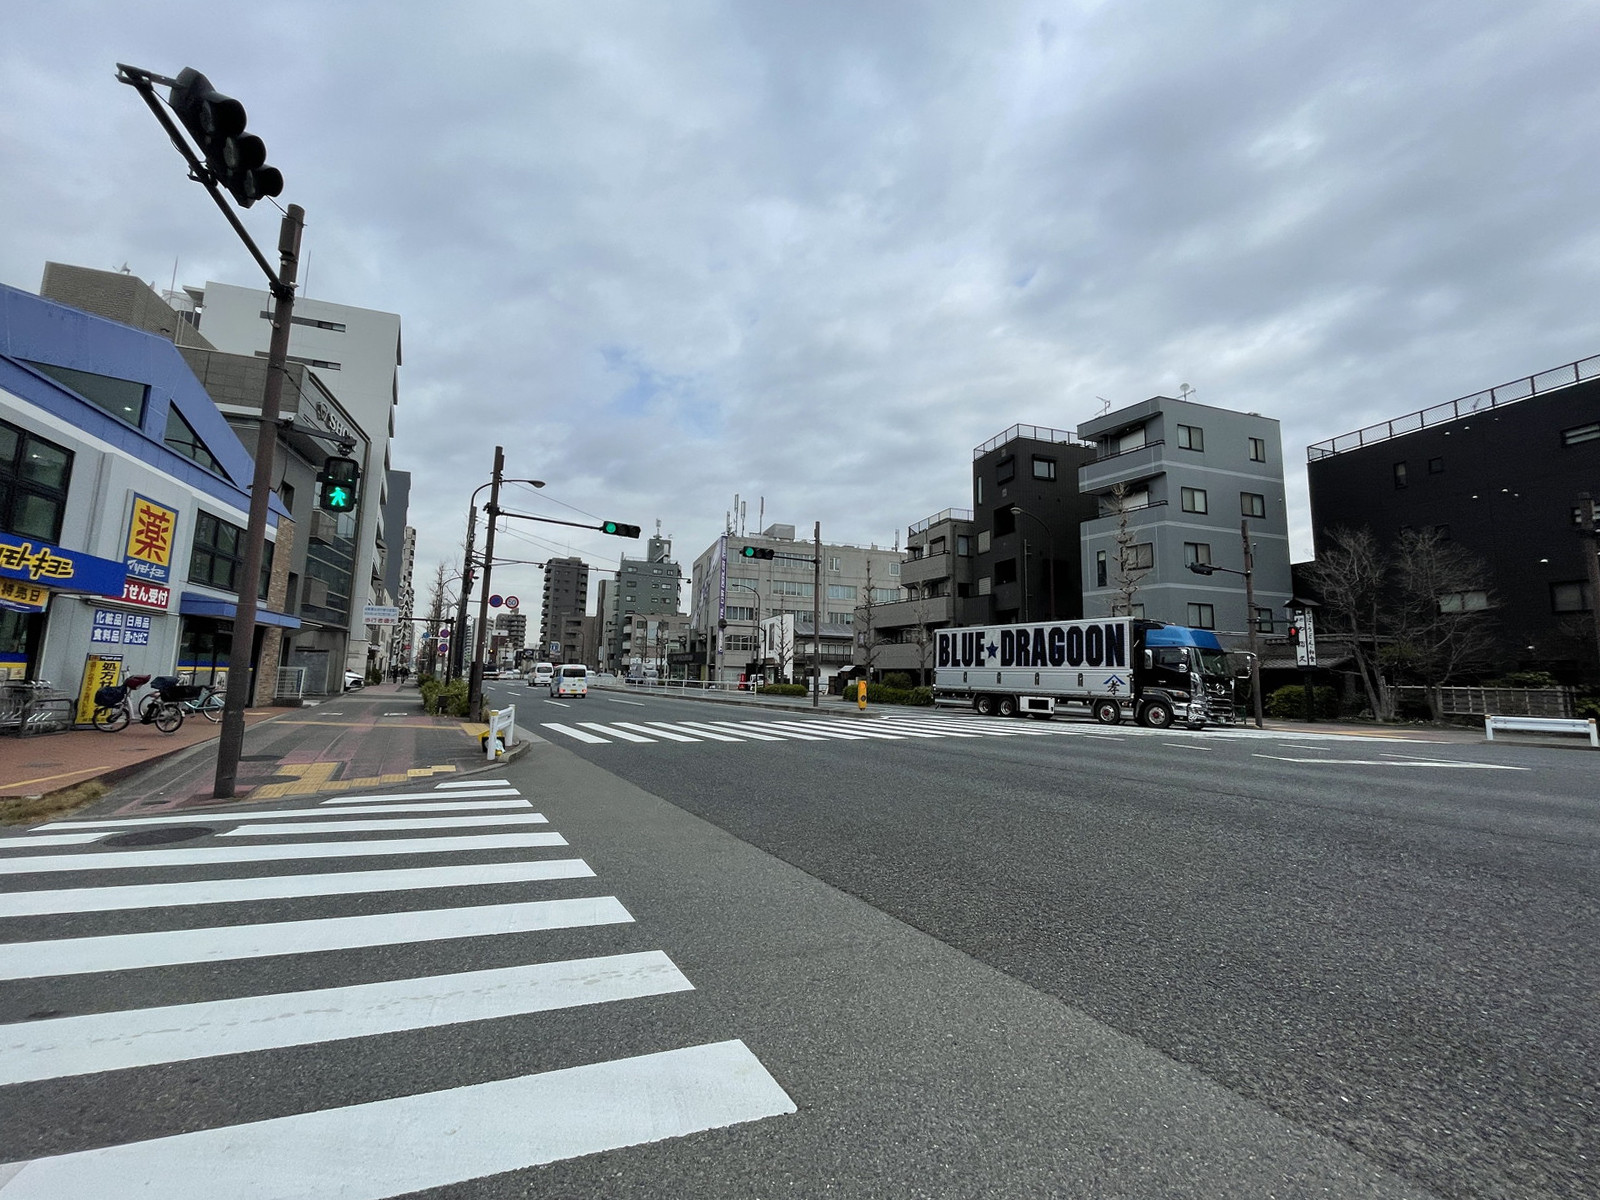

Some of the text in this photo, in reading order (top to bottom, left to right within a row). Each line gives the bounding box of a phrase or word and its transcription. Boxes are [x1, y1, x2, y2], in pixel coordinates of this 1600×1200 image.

[133, 504, 170, 563] 薬
[0, 545, 73, 578] モトキヨシ
[507, 598, 517, 607] 50
[96, 611, 122, 626] 化粧品
[126, 615, 150, 629] 日用品
[92, 628, 120, 642] 食料品
[938, 622, 1126, 667] BLUE DRAGOON
